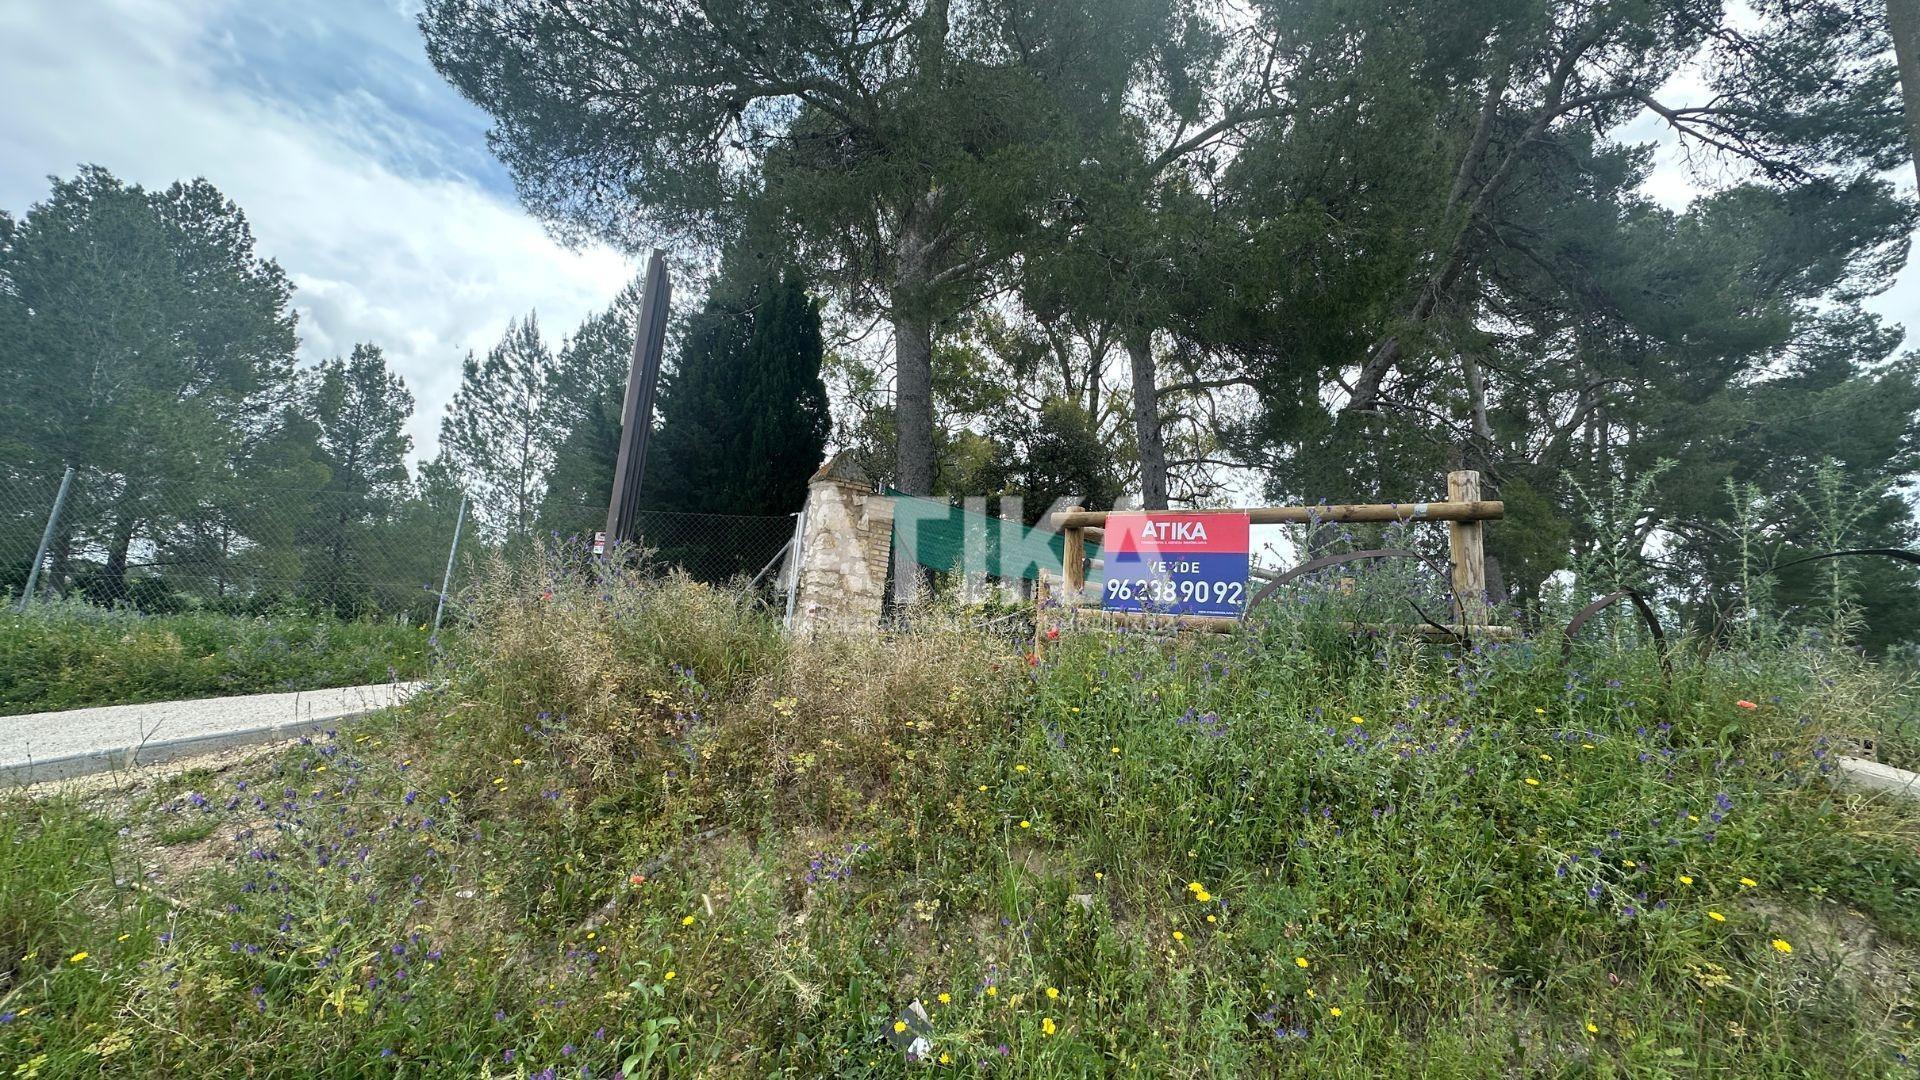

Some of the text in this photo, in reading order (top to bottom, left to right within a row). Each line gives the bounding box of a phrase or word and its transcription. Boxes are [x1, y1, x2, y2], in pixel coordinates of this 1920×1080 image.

[1141, 520, 1207, 540] ATIKA
[1107, 578, 1242, 605] 96 238 90 92
